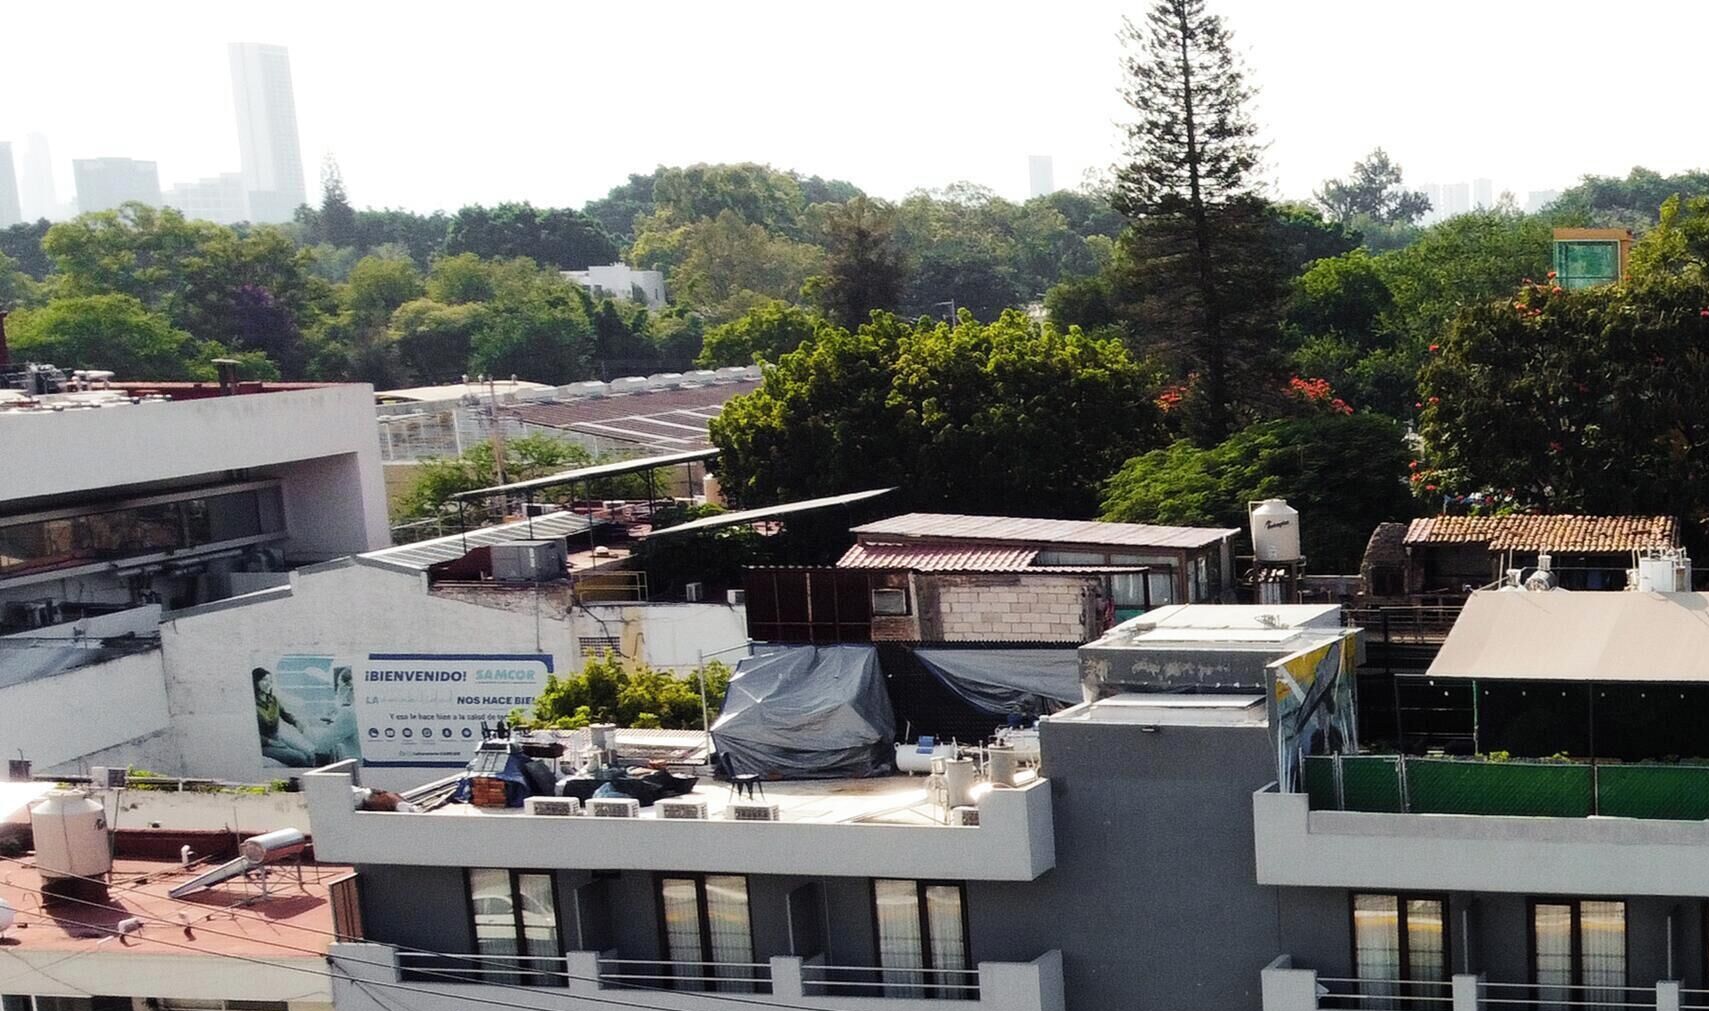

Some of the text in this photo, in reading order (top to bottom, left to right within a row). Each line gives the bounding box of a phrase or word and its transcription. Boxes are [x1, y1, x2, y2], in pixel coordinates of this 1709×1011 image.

[365, 671, 467, 682] ¡BIENVENIDO!
[475, 669, 536, 681] SAMCOR
[457, 696, 480, 705] NOS
[482, 696, 513, 705] HACE
[514, 696, 536, 705] BIE
